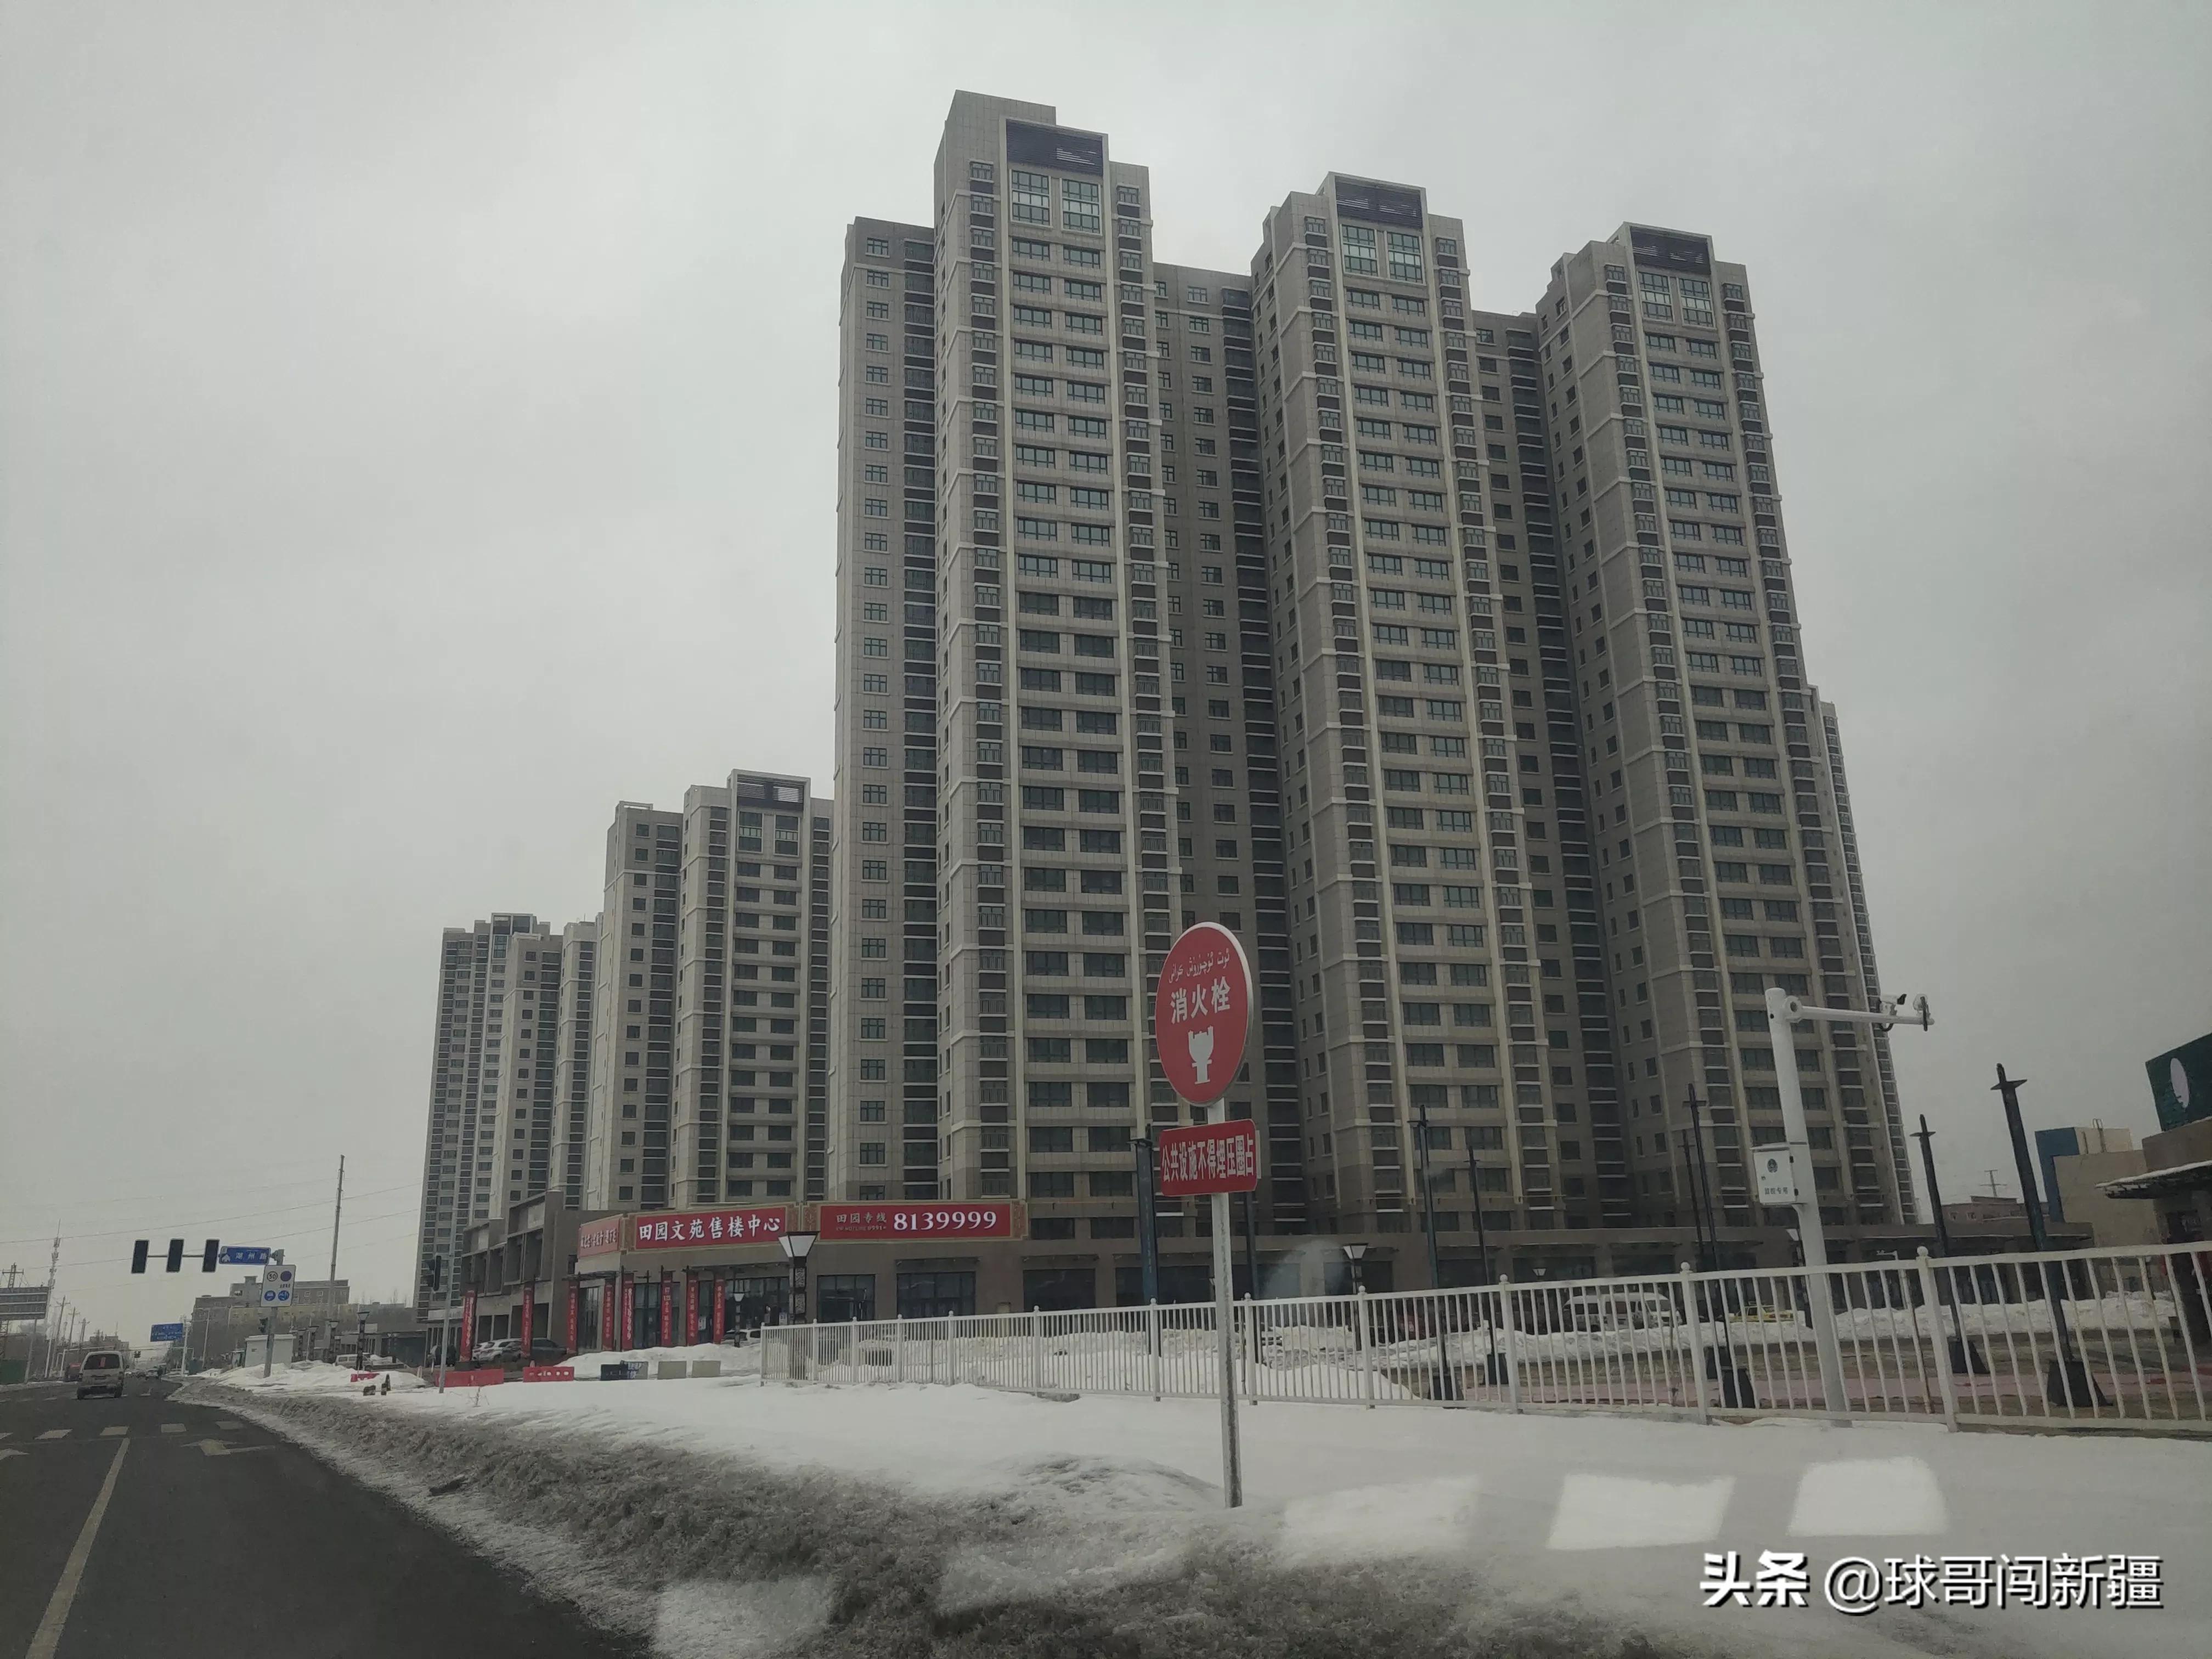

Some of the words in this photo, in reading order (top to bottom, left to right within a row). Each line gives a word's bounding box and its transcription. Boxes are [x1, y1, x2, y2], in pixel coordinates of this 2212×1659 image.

[1170, 975, 1231, 1024] 消火栓
[1162, 1133, 1254, 1182] 公共设施不得埋压圈占
[638, 1214, 781, 1242] 田园文苑售楼中心
[836, 1211, 887, 1224] 田园专线
[893, 1211, 997, 1232] 8139999
[235, 1251, 267, 1260] 湖州路
